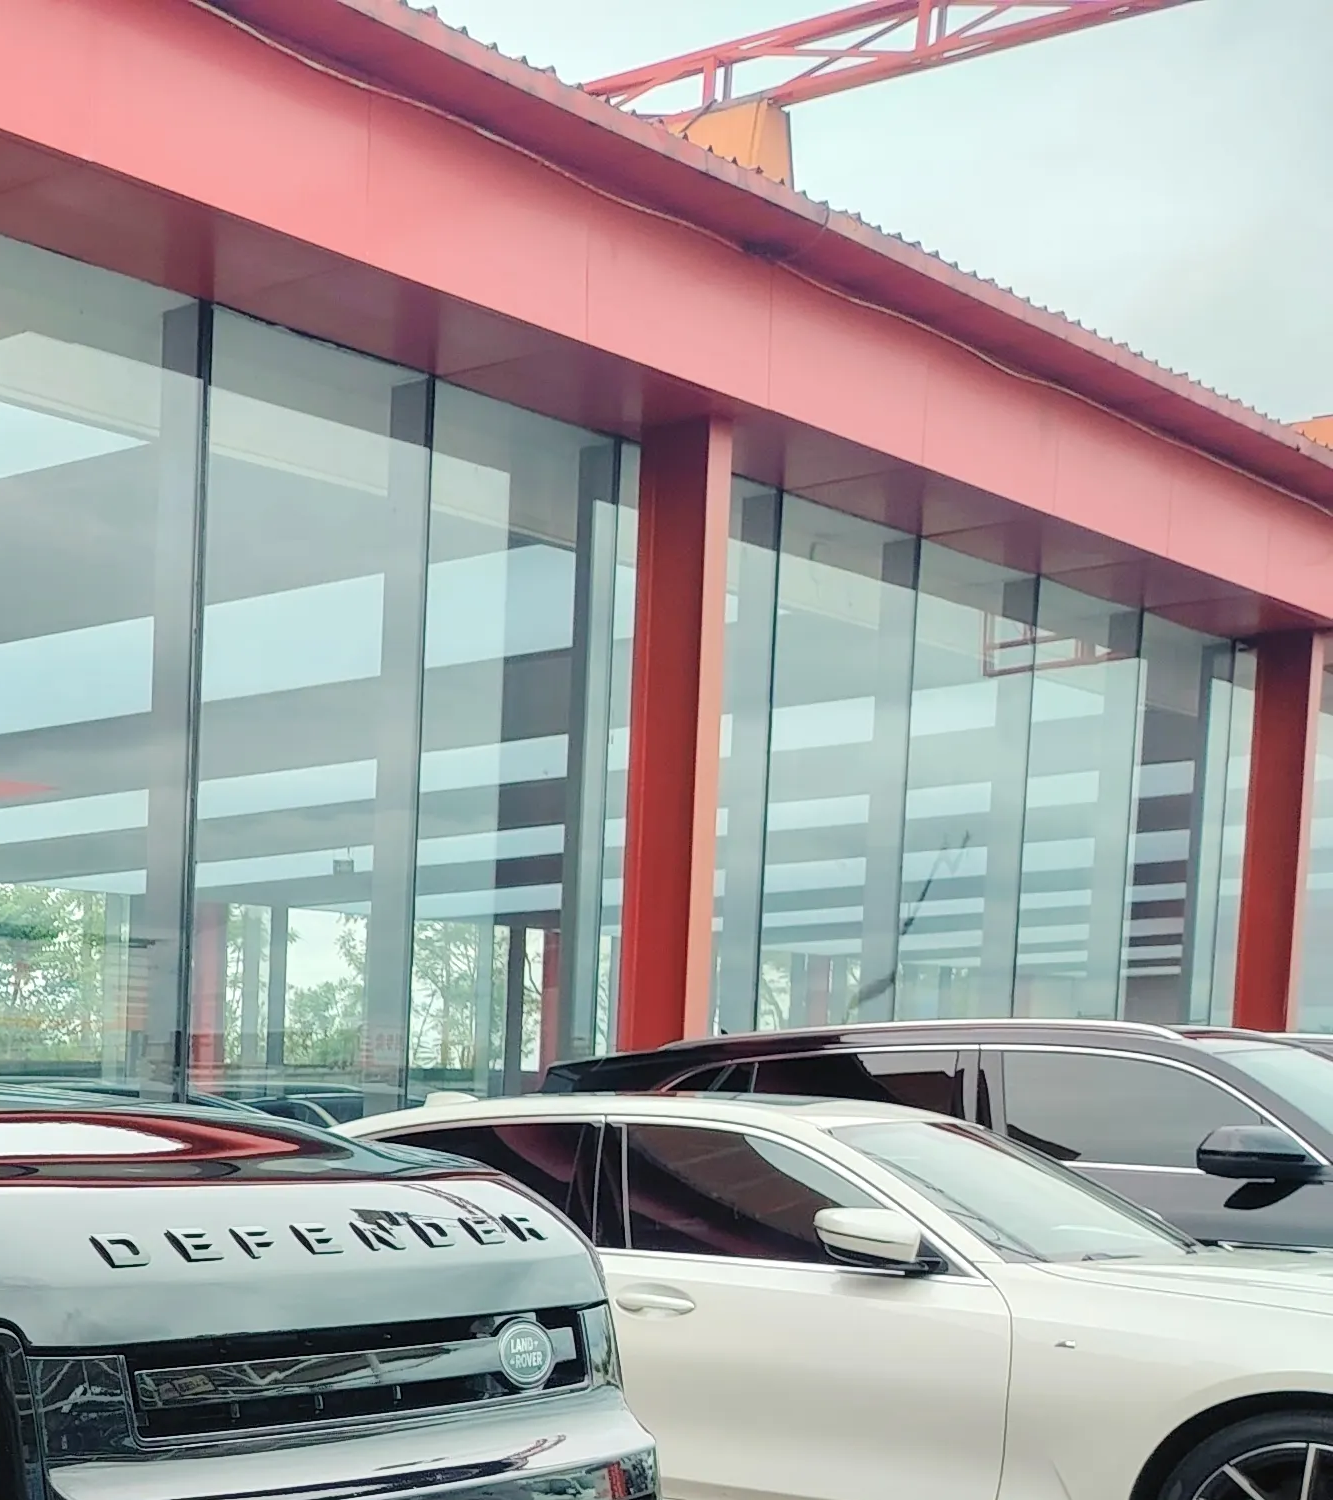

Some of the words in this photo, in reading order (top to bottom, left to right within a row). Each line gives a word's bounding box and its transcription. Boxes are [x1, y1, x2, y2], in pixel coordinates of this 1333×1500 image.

[89, 1212, 548, 1269] DEFENDER
[510, 1336, 534, 1354] LAND
[515, 1351, 543, 1369] ROVER
